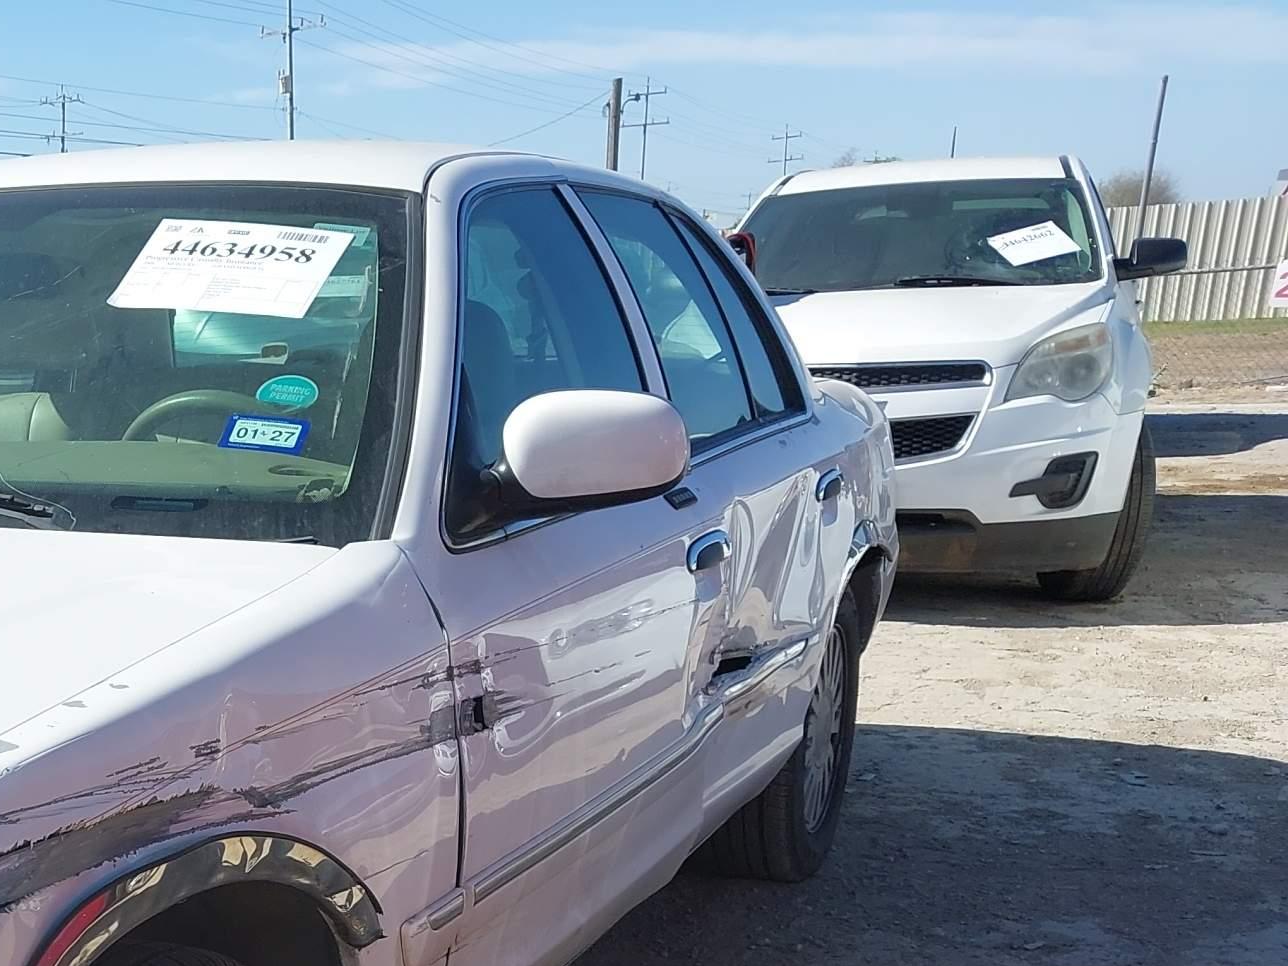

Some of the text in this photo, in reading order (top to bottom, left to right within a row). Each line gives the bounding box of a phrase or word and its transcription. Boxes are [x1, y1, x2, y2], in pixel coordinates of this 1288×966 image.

[163, 239, 316, 264] 44634958
[269, 384, 312, 395] PARKING
[268, 391, 306, 402] PERMIT
[236, 427, 296, 442] 01 27
